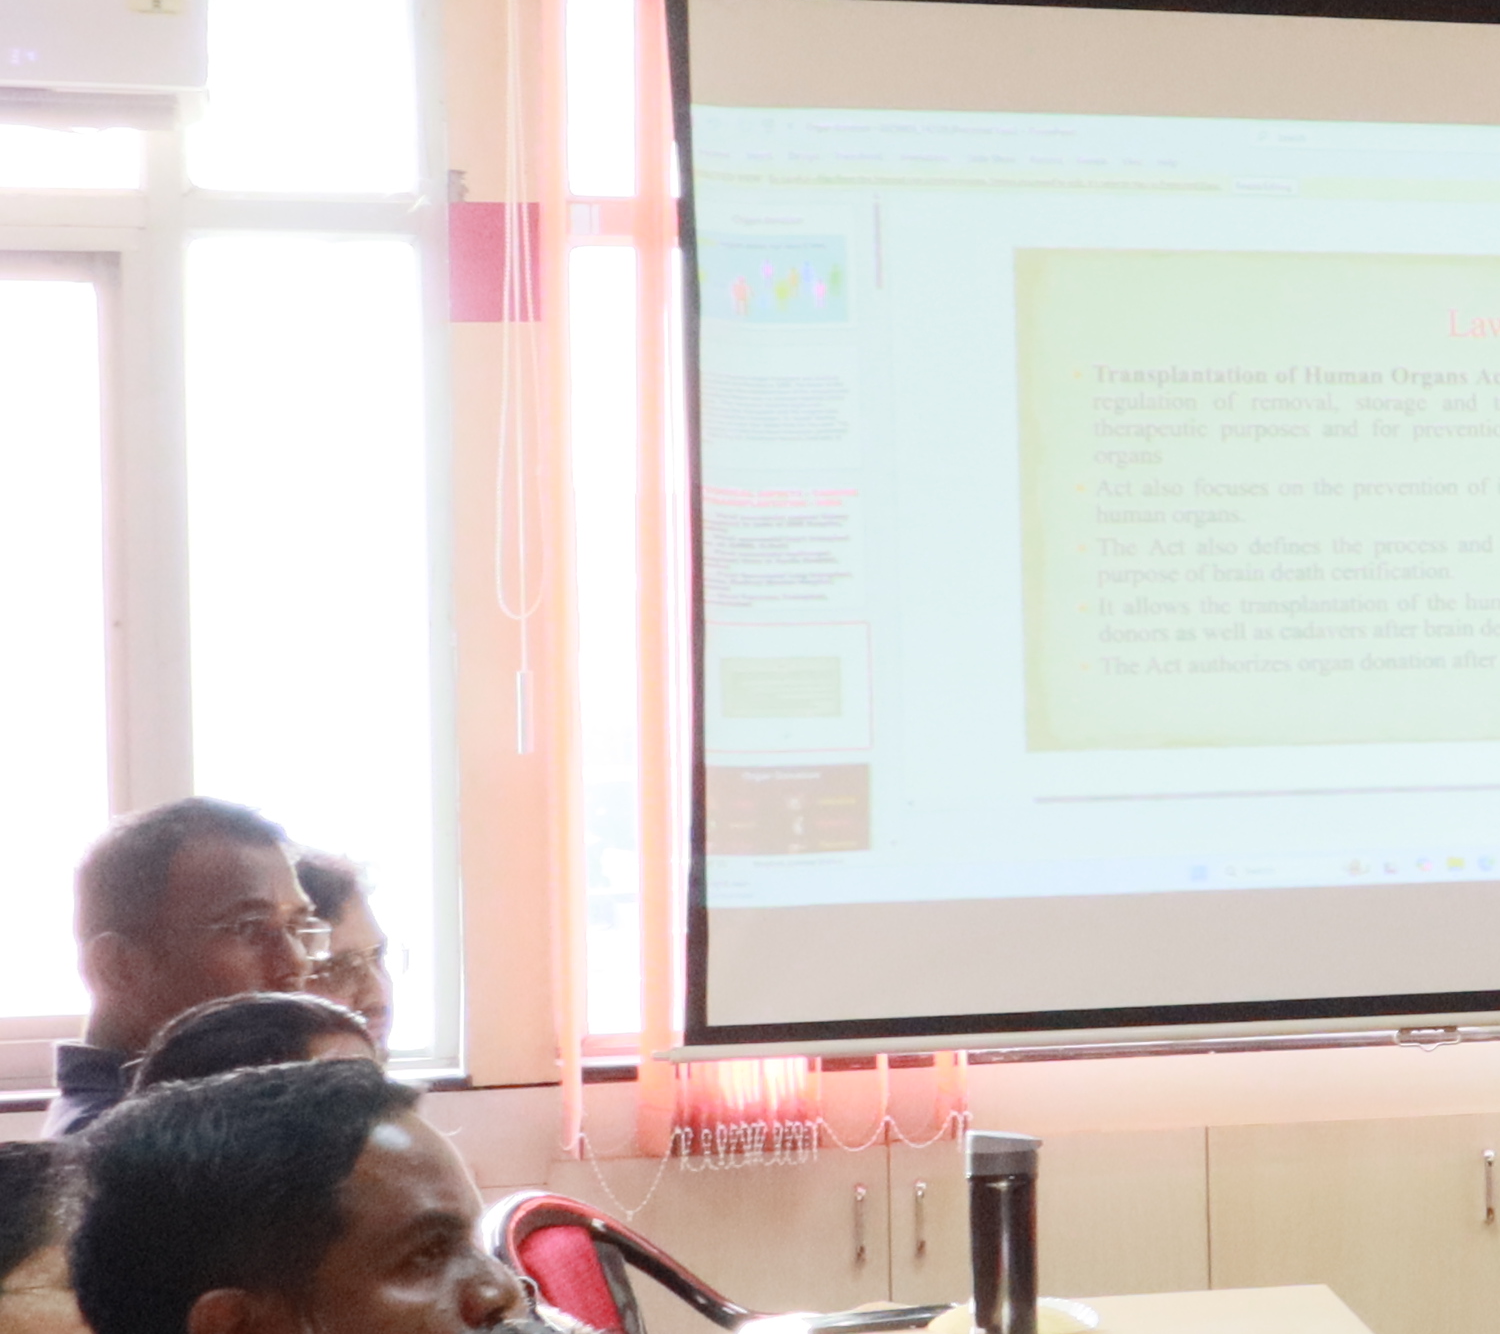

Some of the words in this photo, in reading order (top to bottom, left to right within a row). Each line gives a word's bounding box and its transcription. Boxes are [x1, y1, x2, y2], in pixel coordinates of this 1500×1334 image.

[1092, 366, 1269, 388] Transplantation
[1273, 366, 1299, 384] of
[1304, 366, 1384, 386] Human
[1389, 367, 1469, 389] Organs
[1092, 393, 1198, 415] regulation
[1211, 392, 1238, 411] of
[1250, 393, 1340, 413] removal,
[1355, 396, 1428, 417] storage
[1441, 394, 1478, 413] and
[1093, 419, 1208, 443] therapeutic
[1220, 425, 1311, 443] purposes
[1321, 419, 1360, 438] and
[1371, 418, 1401, 438] for
[1091, 450, 1164, 471] organs
[1096, 478, 1133, 497] Act
[1140, 478, 1184, 497] also
[1193, 478, 1270, 497] focuses
[1277, 484, 1305, 497] on
[1312, 478, 1345, 497] the
[1352, 480, 1459, 501] prevention
[1466, 477, 1491, 496] of
[1095, 507, 1167, 524] human
[1171, 510, 1247, 528] organs.
[1096, 537, 1137, 556] The
[1148, 537, 1186, 556] Act
[1195, 537, 1239, 556] also
[1247, 536, 1323, 556] defines
[1331, 536, 1363, 555] the
[1373, 540, 1449, 559] process
[1457, 535, 1494, 553] and
[1096, 570, 1180, 588] purpose
[1184, 563, 1210, 583] of
[1211, 563, 1265, 582] brain
[1269, 563, 1326, 582] death
[1330, 562, 1455, 581] certification.
[1097, 596, 1114, 616] It
[1122, 595, 1191, 616] allows
[1199, 595, 1231, 614] the
[1239, 594, 1390, 616] transplantation
[1396, 593, 1421, 611] of
[1425, 593, 1457, 611] the
[1097, 623, 1171, 644] donors
[1174, 627, 1198, 642] as
[1202, 622, 1247, 641] well
[1252, 628, 1275, 640] as
[1278, 621, 1368, 640] cadavers
[1372, 620, 1419, 638] after
[1423, 619, 1475, 638] brain
[1099, 655, 1140, 676] The
[1144, 654, 1182, 674] Act
[1187, 653, 1293, 674] authorizes
[1296, 658, 1355, 677] organ
[1358, 651, 1447, 671] donation
[1451, 649, 1498, 669] after
